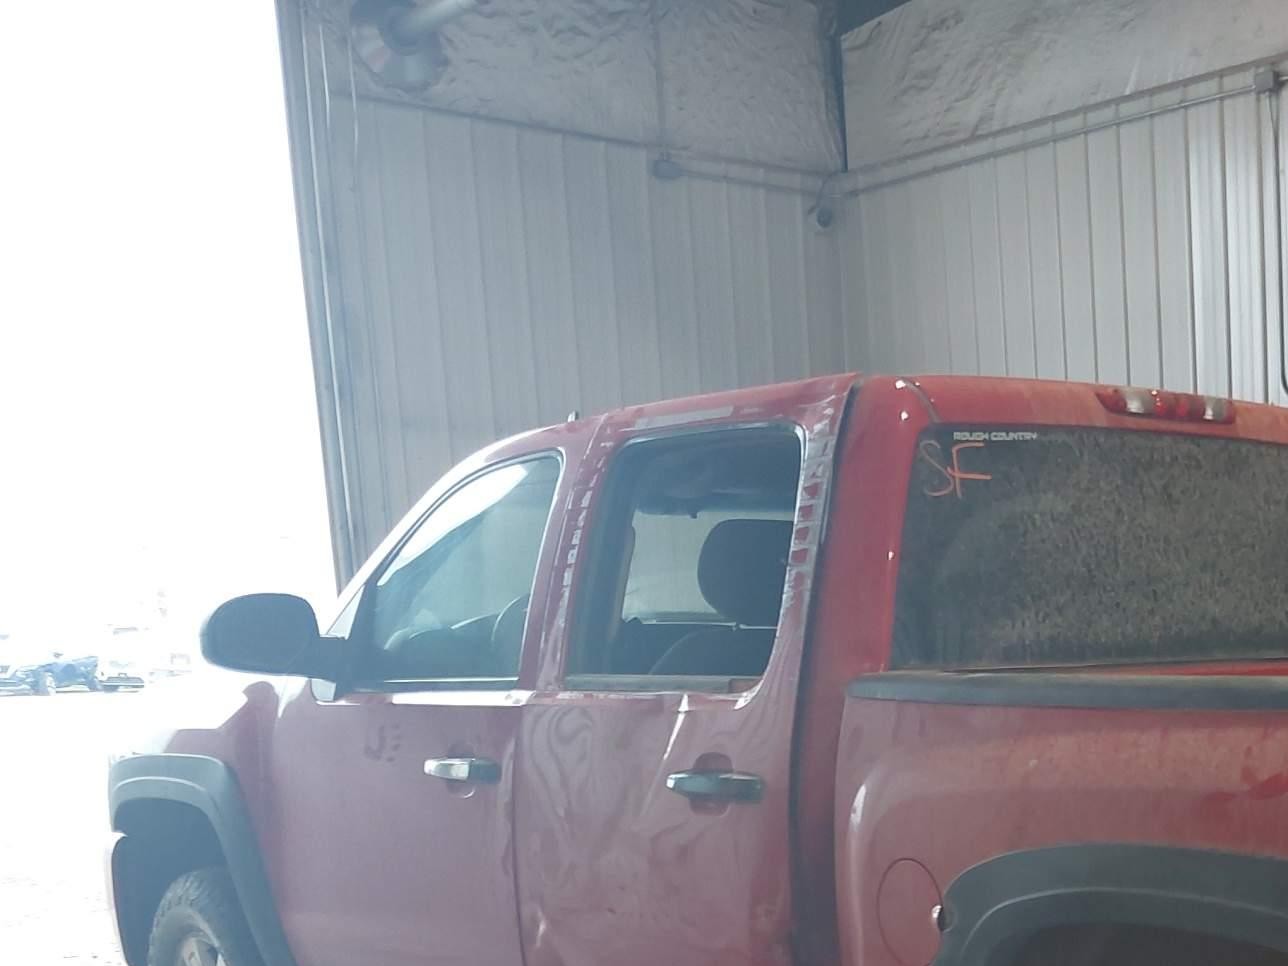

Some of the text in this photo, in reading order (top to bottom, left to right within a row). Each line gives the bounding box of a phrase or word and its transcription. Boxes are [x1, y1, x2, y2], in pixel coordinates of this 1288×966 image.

[953, 432, 1038, 441] ROUGH COUNTRY
[919, 440, 993, 499] SF
